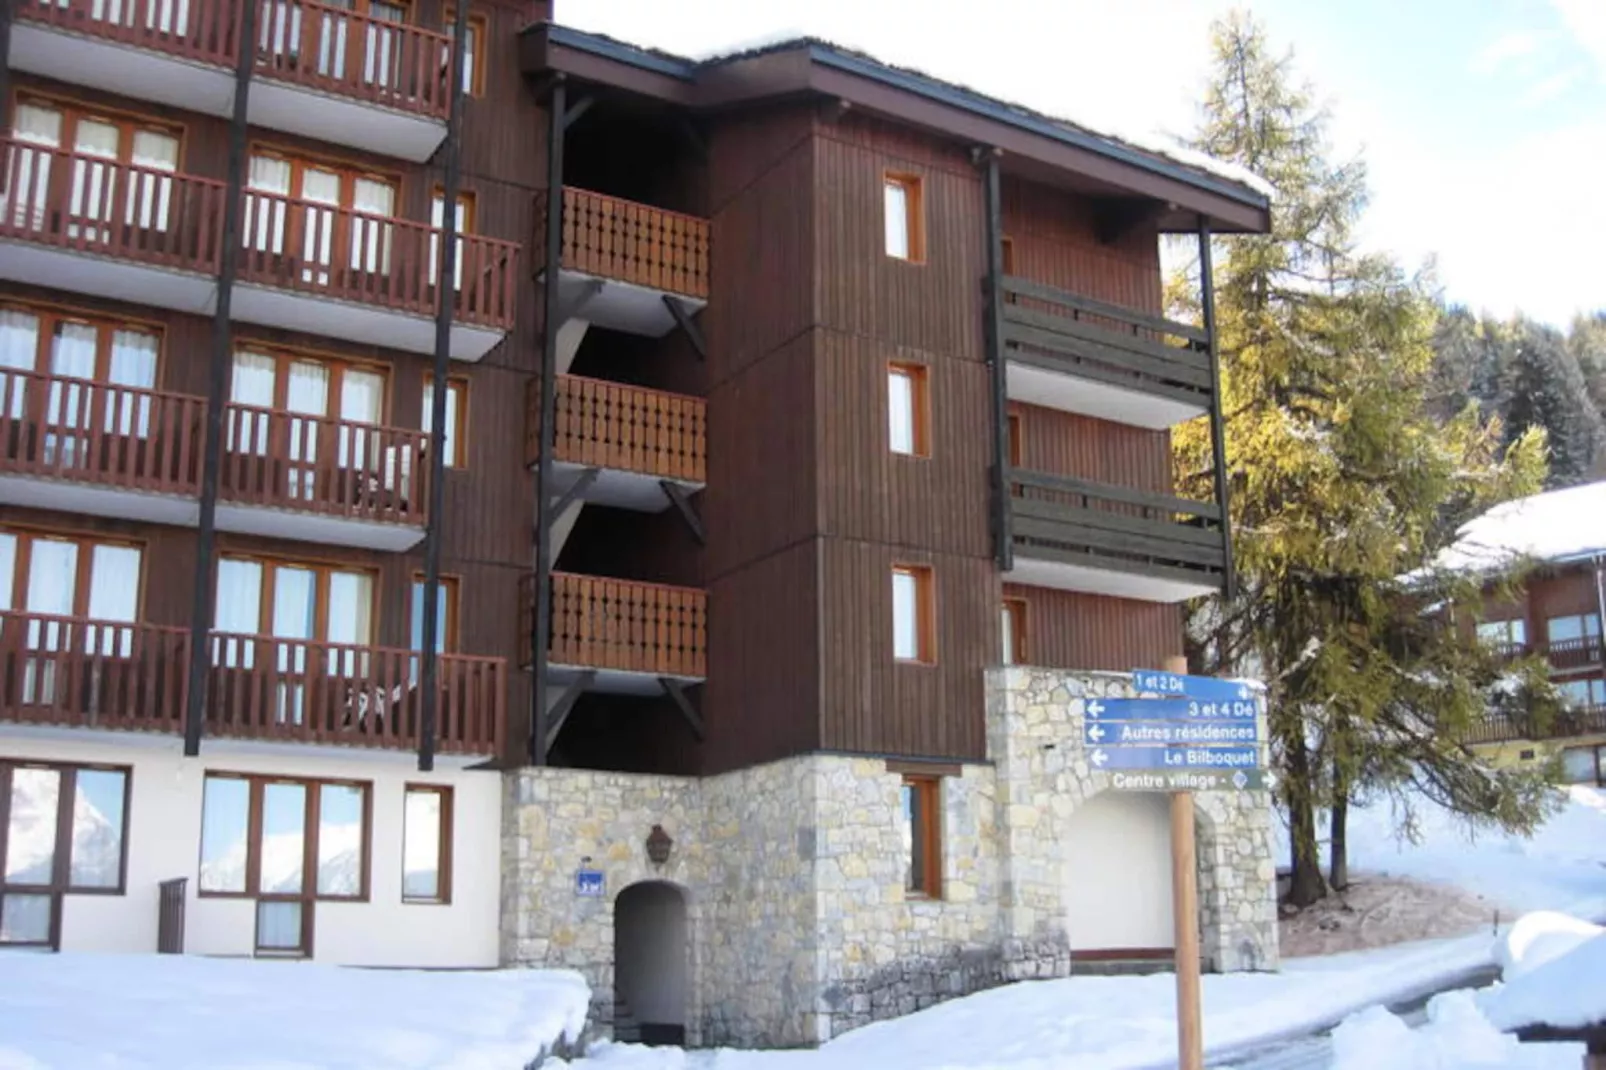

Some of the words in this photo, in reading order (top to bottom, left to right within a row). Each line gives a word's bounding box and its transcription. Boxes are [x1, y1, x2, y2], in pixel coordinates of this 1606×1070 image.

[1159, 676, 1167, 689] 2
[1189, 702, 1198, 716] 3
[1202, 702, 1218, 716] et
[1221, 702, 1230, 716] 4
[1122, 726, 1170, 739] Autres
[1175, 725, 1255, 739] résidences
[1164, 750, 1182, 764] Le
[1187, 750, 1254, 766] Bilboquet
[1113, 772, 1164, 788] Centre
[1169, 772, 1216, 791] village
